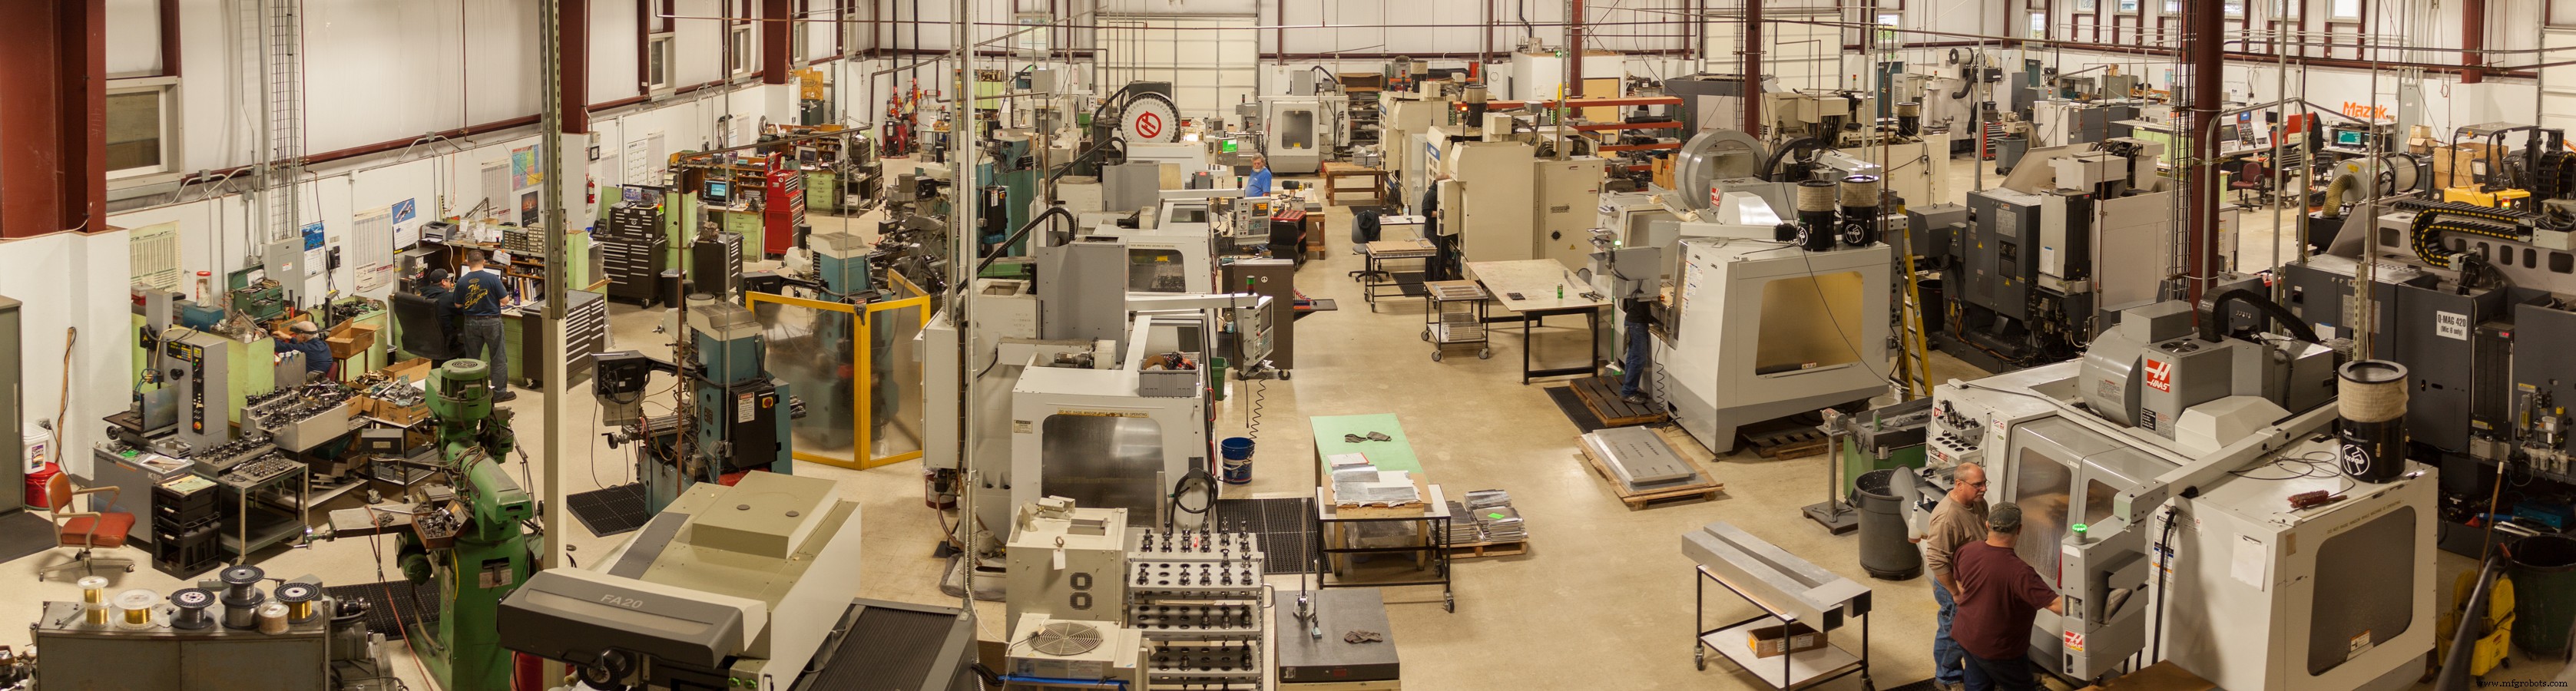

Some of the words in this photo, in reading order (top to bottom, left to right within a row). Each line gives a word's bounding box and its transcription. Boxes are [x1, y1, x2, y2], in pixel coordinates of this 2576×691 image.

[2343, 101, 2387, 120] Mazak
[468, 283, 480, 292] The
[2455, 317, 2466, 327] 420
[2147, 379, 2170, 391] HAAS
[600, 594, 643, 608] FA20
